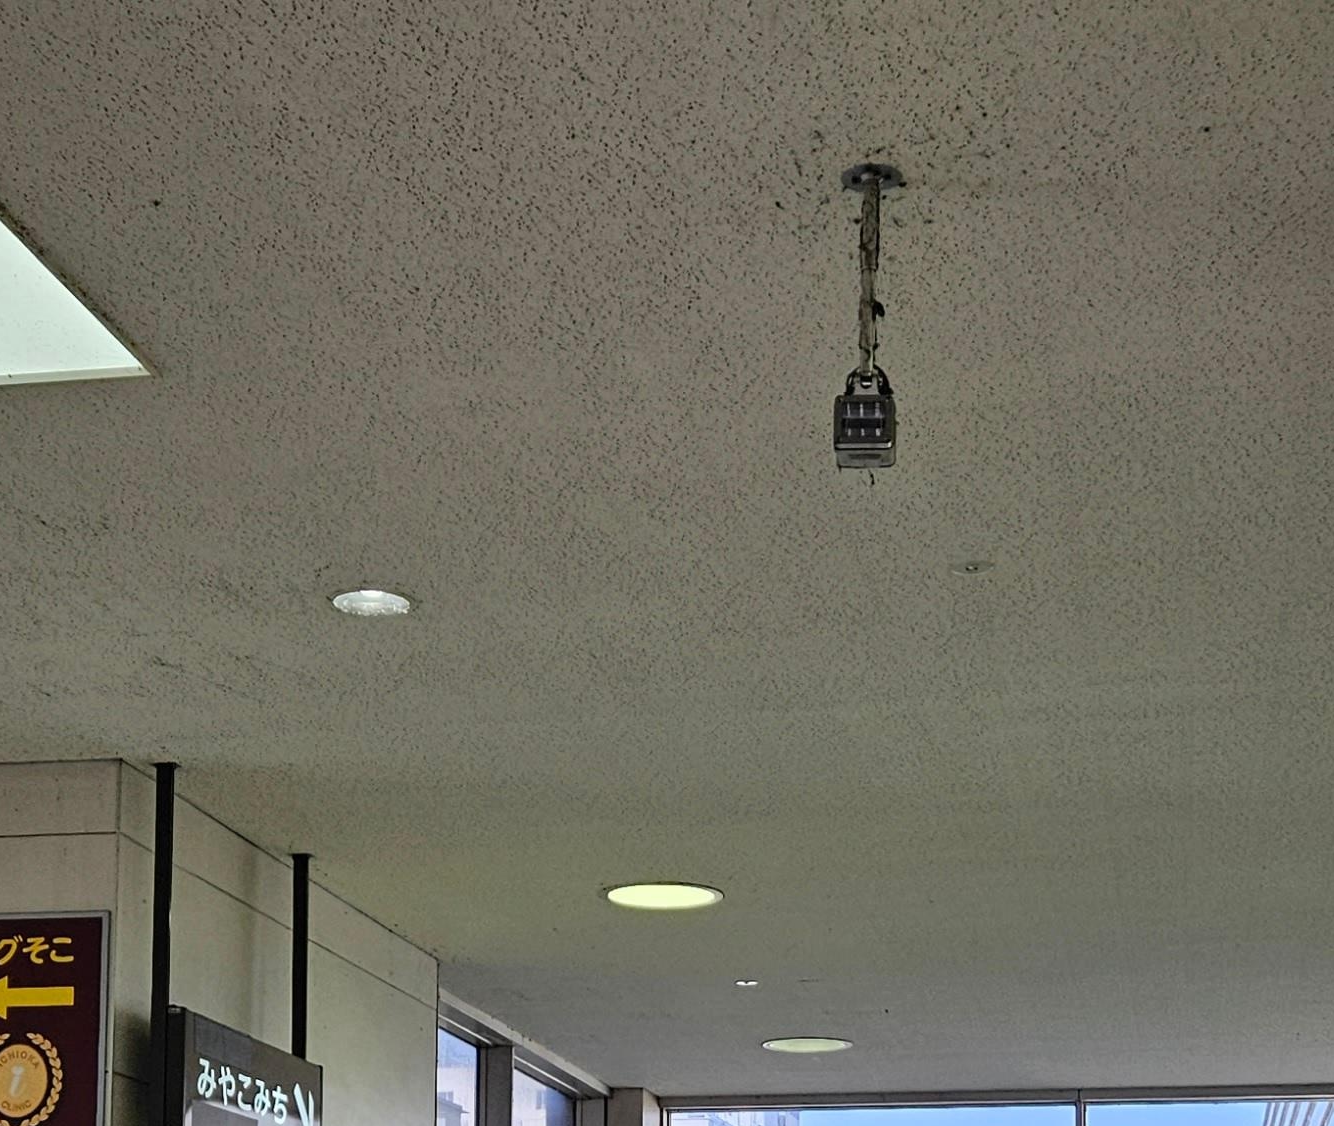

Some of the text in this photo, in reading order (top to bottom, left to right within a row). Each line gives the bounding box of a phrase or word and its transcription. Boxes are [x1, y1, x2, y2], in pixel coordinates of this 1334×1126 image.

[1, 1100, 32, 1112] CLINIC
[197, 1057, 289, 1126] みやこみち
